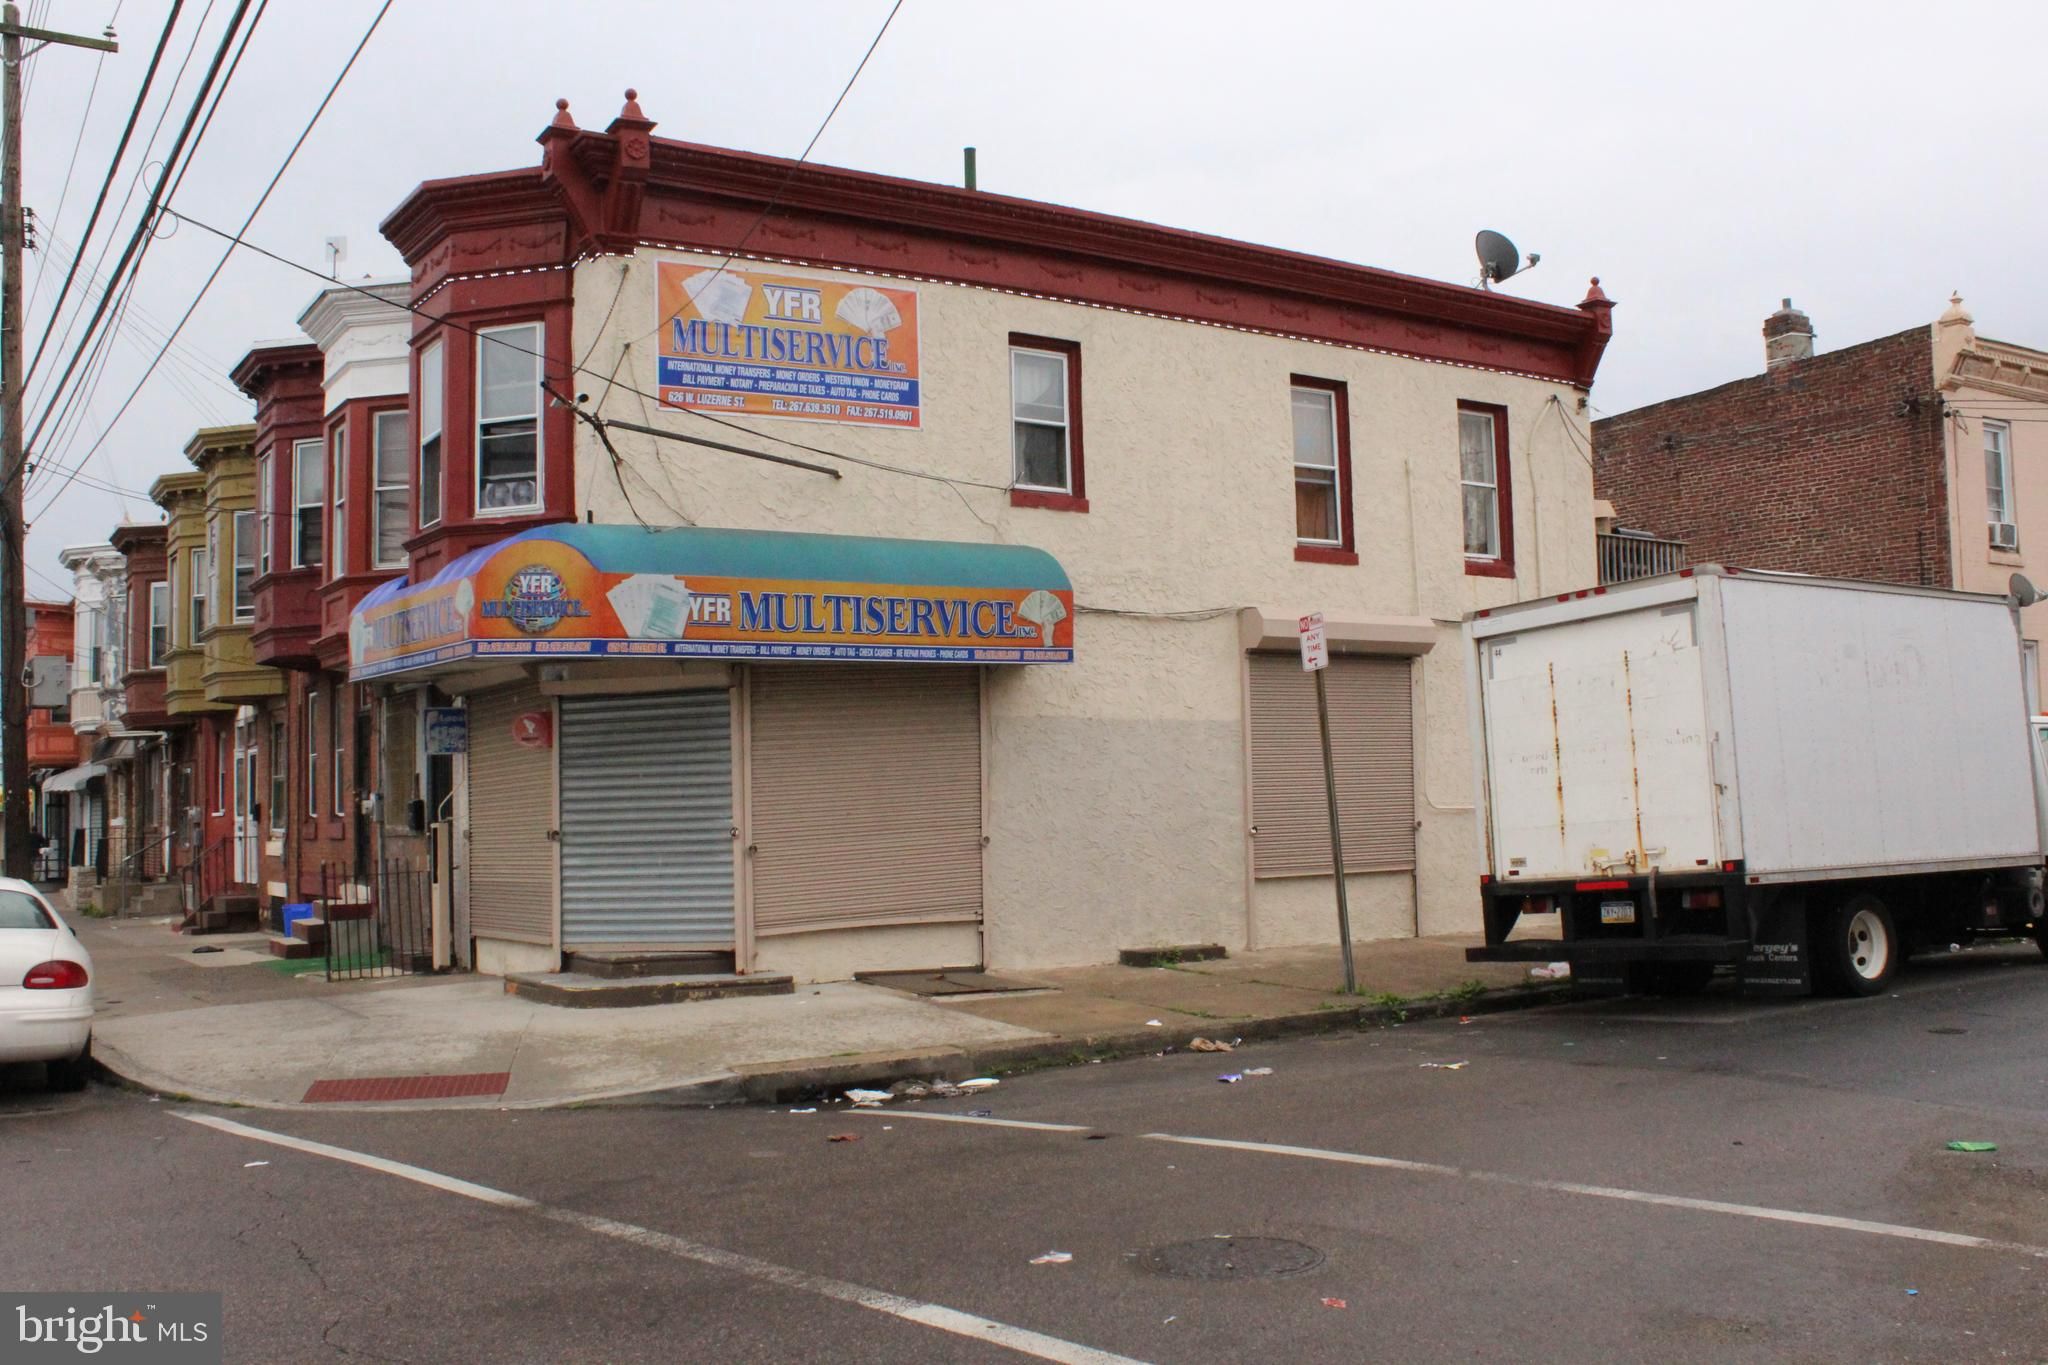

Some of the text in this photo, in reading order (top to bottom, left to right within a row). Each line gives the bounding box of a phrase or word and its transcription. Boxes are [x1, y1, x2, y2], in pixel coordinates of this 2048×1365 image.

[763, 286, 821, 321] YFR
[672, 316, 888, 371] MULTISERVICE
[667, 360, 909, 391] INTERNATIONAL MONEY TRANSFERS MONEY ORDERS WESTERN UNION MONEYGRAM
[682, 373, 899, 402] BILL PAYMENT NOTARY PREPARACION DE TAXES AUTO TAG PHONE CARDS
[668, 391, 684, 402] 626
[686, 393, 695, 403] W.
[697, 393, 732, 406] LUZERNE
[733, 396, 745, 407] ST.
[772, 399, 787, 411] TEL:
[846, 405, 863, 416] FAX:
[519, 575, 552, 593] YFR
[688, 596, 731, 622] YFR
[738, 591, 1018, 638] MULTISERVICE
[1306, 632, 1320, 642] ANY
[1307, 643, 1321, 653] TIME
[1752, 942, 1799, 954] ergey's
